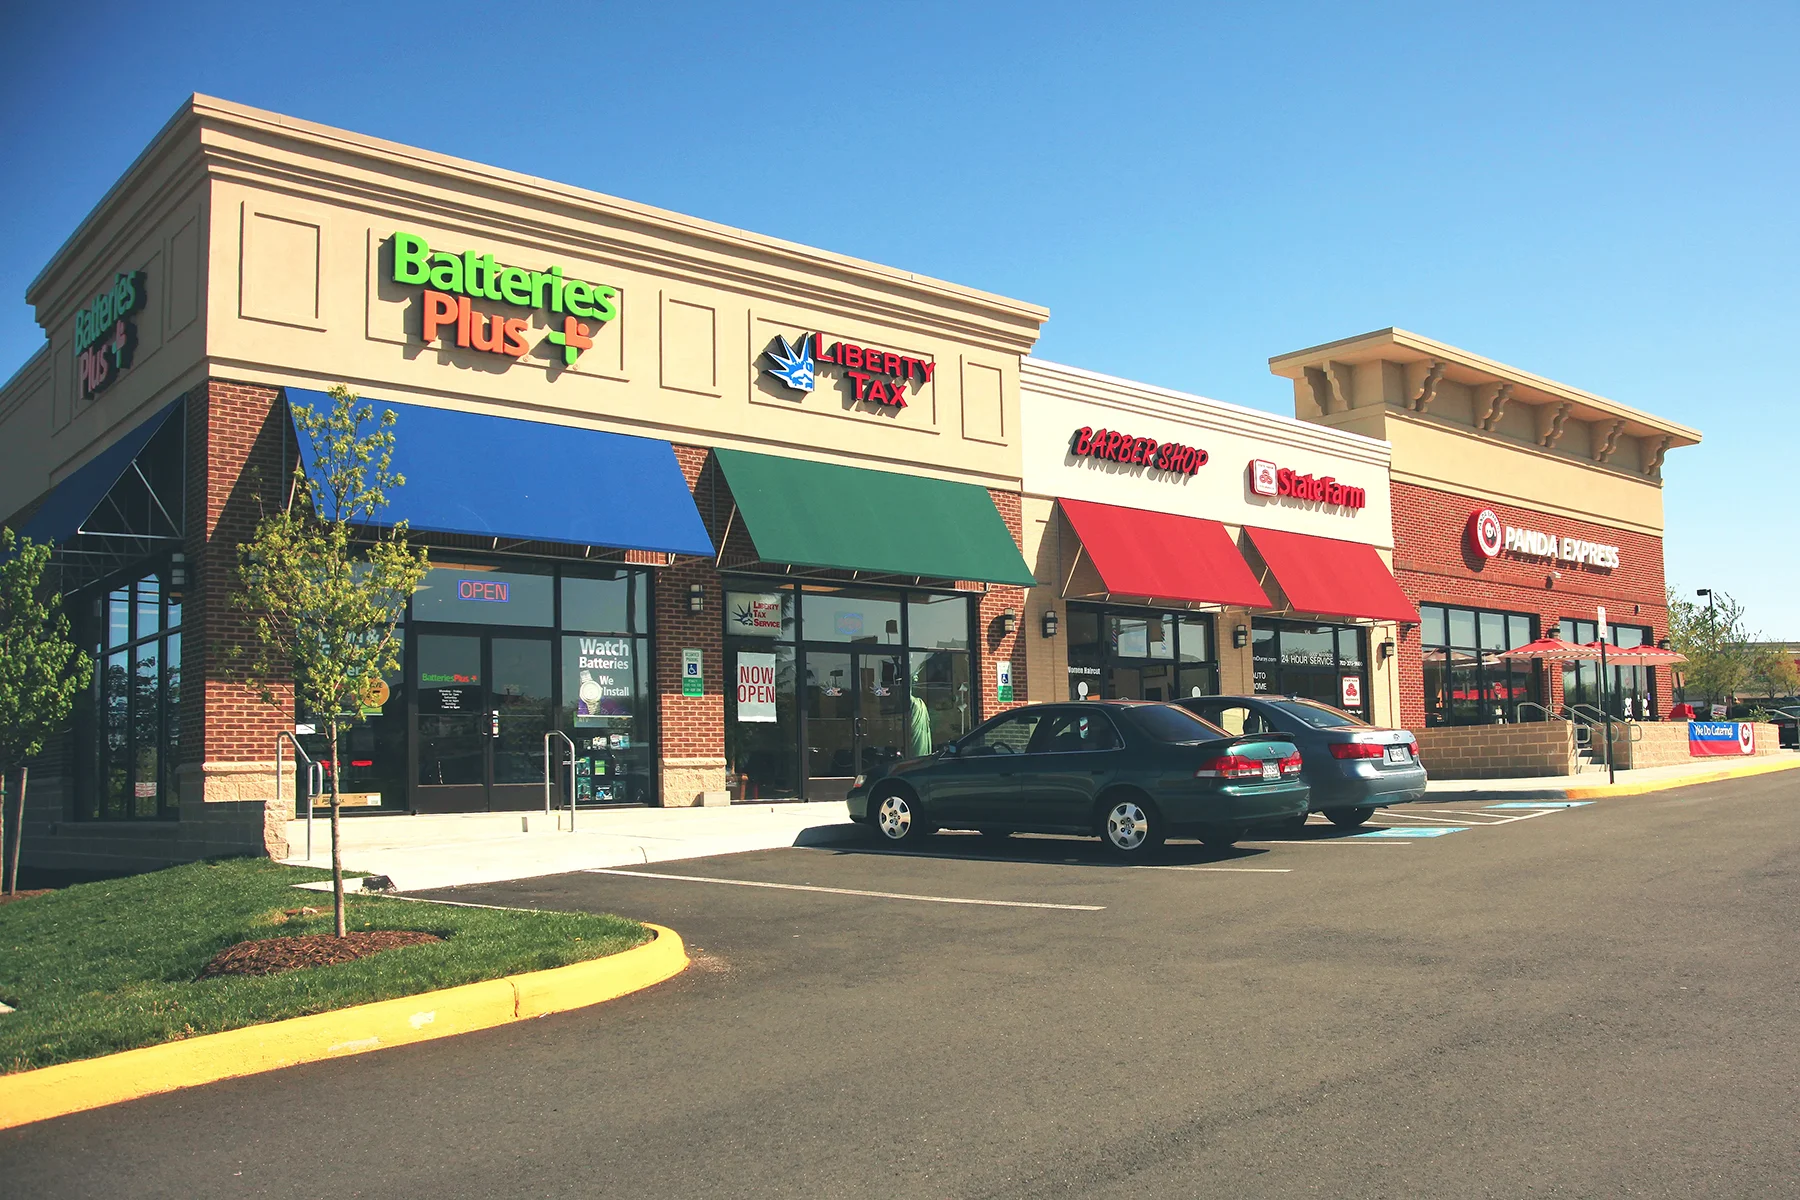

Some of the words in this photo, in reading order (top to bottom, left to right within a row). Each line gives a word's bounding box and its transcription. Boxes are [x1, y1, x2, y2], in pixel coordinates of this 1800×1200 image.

[395, 231, 616, 321] Batteries
[75, 271, 136, 357] Batteries
[423, 289, 529, 357] Plus
[815, 332, 936, 382] LIBERTY
[80, 344, 108, 400] Plus
[848, 371, 908, 407] TAX
[1076, 426, 1158, 467] BARBER
[1158, 442, 1209, 475] SHOP
[1505, 526, 1559, 558] PANDA
[1563, 538, 1620, 568] EXPRESS
[461, 581, 507, 601] OPEN
[753, 601, 780, 611] LIBERTY
[753, 610, 766, 619] TAX
[753, 618, 781, 628] SERVICE
[580, 638, 629, 657] Watch
[579, 656, 629, 670] Batteries
[1281, 654, 1289, 664] 24
[1291, 656, 1308, 665] HOUR
[600, 675, 614, 686] We
[740, 666, 774, 684] NOW
[603, 686, 630, 697] Install
[737, 685, 775, 703] OPEN
[1694, 725, 1704, 736] We
[1703, 725, 1711, 736] Do
[1711, 725, 1733, 739] Catering!
